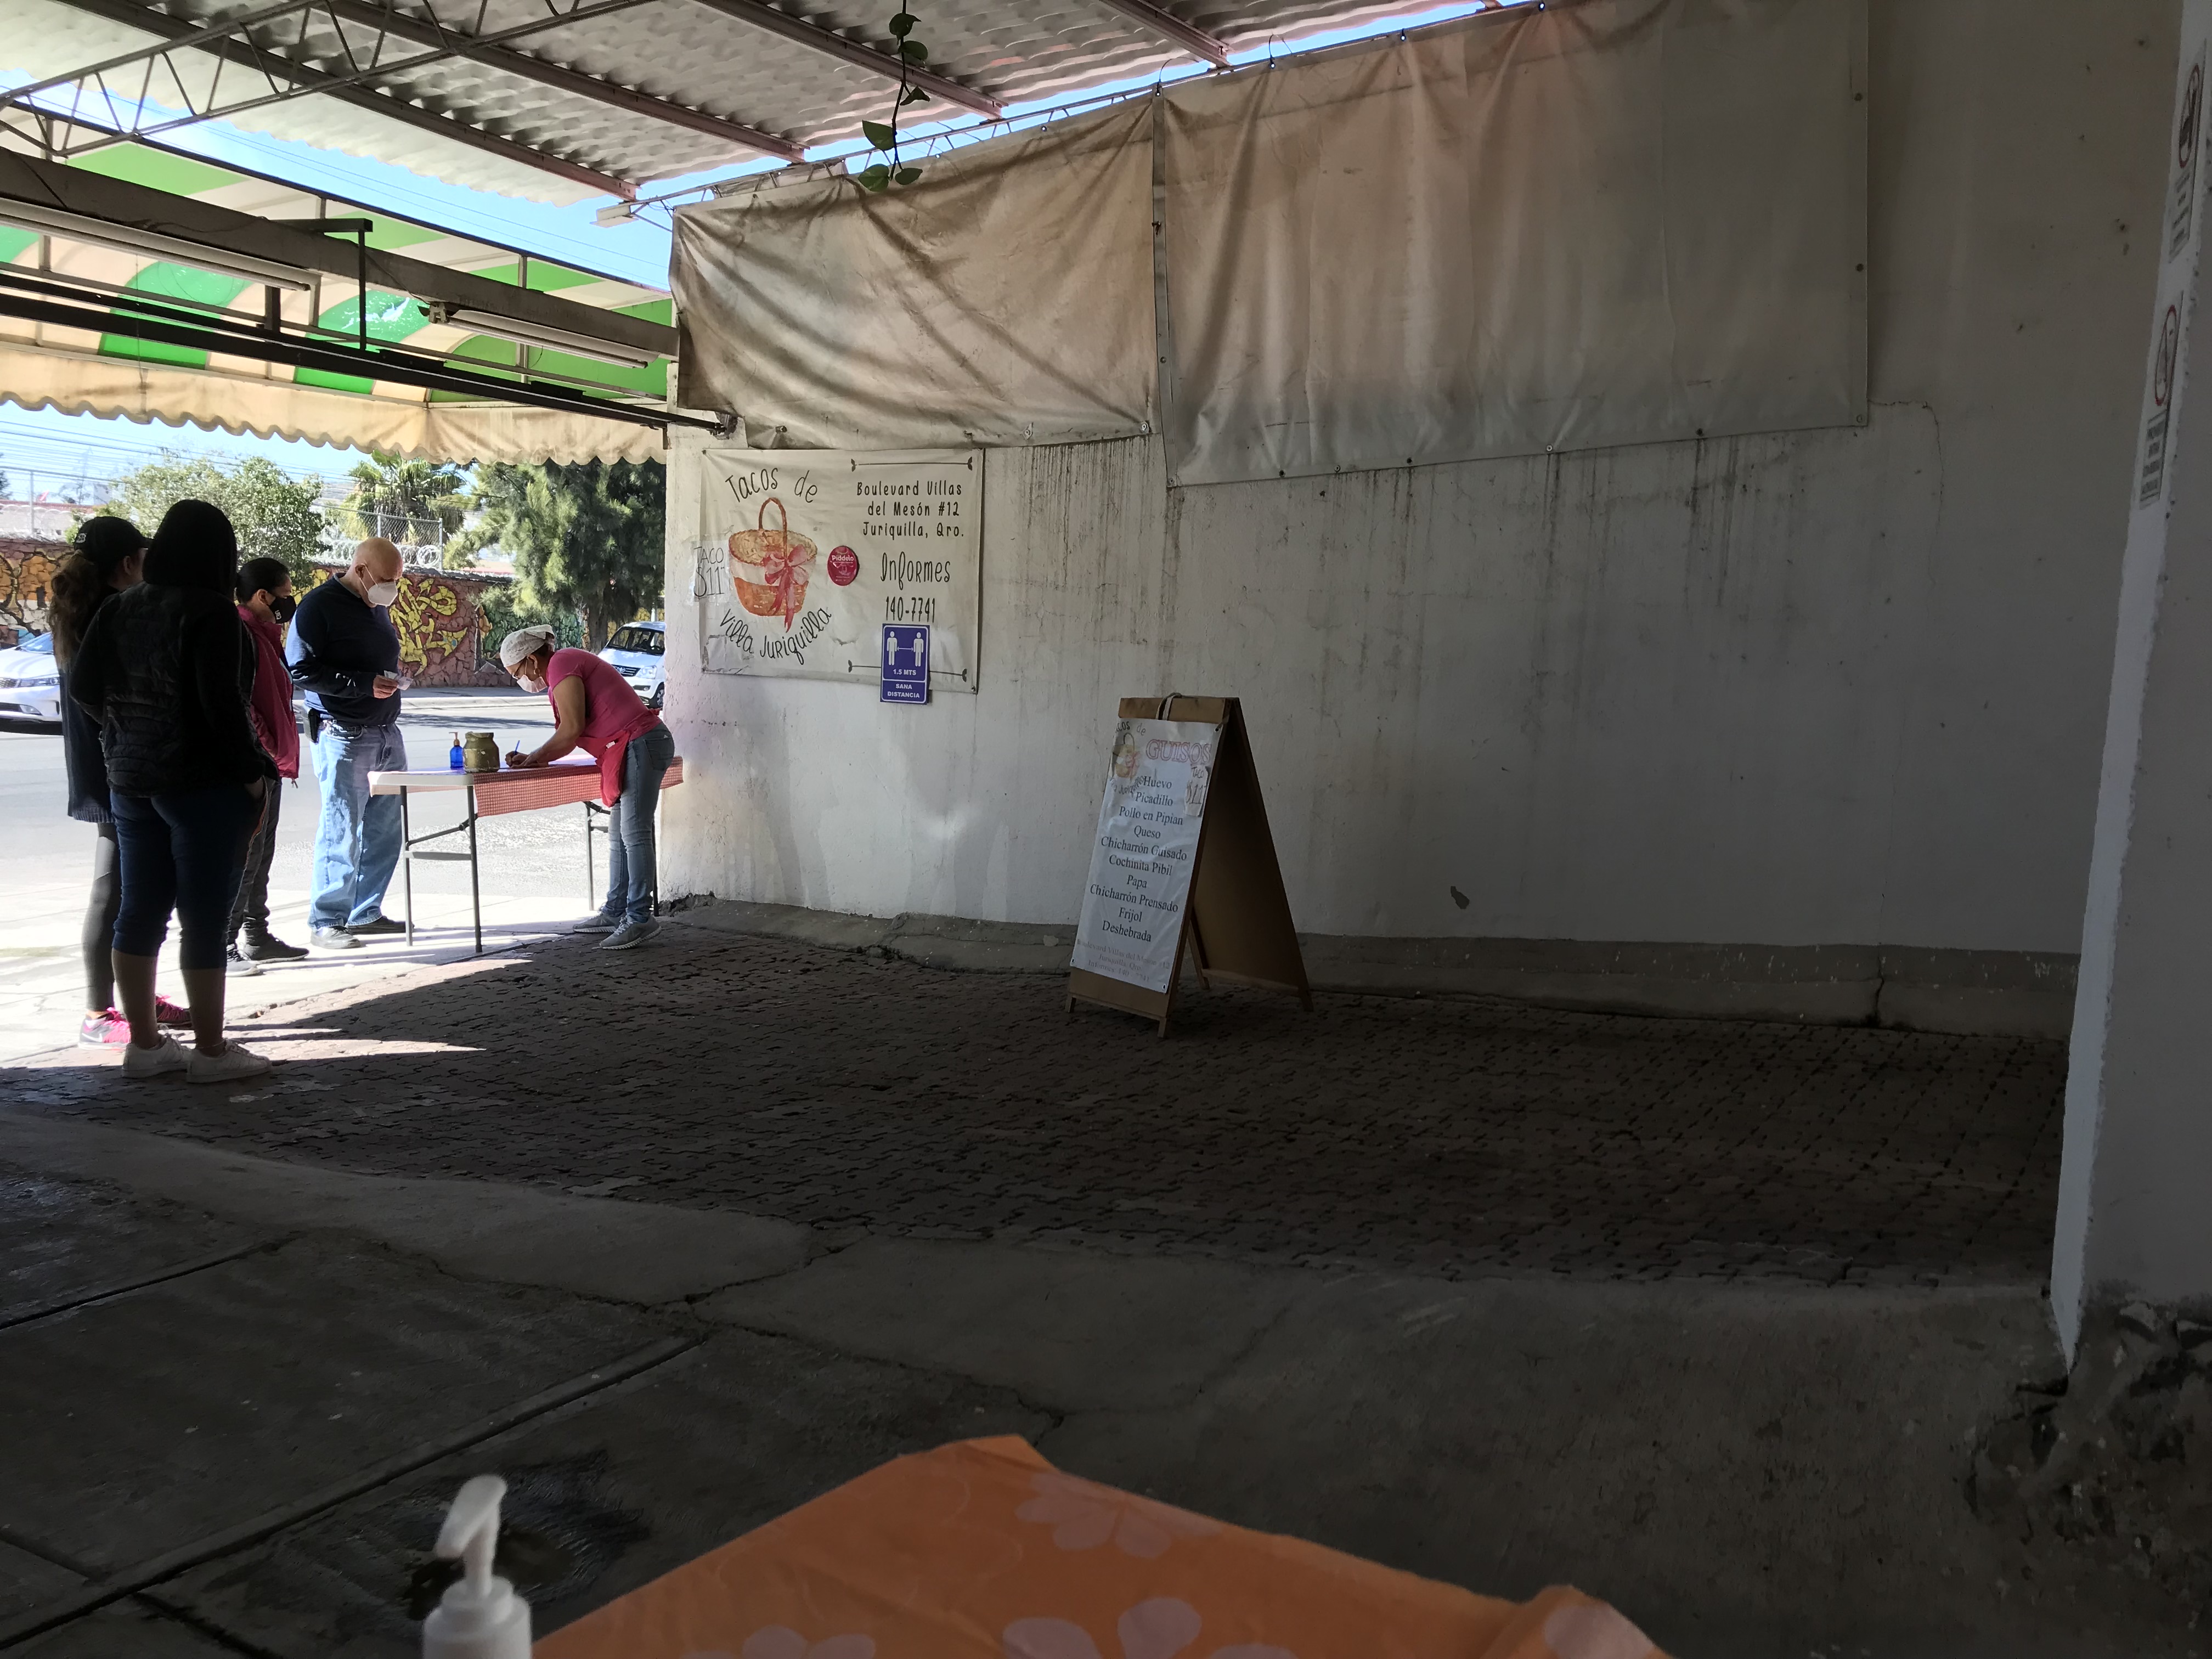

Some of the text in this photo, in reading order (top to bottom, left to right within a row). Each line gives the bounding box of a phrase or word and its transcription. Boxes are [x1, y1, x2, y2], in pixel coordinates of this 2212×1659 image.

[725, 467, 818, 504] Tacos de
[856, 481, 962, 496] Boulevard Villas
[867, 501, 960, 517] del Mesón #12
[863, 521, 964, 538] Juriquilla, Qro.
[693, 546, 724, 564] TACO
[885, 596, 936, 624] 140-7741
[719, 608, 754, 654] Villa
[887, 690, 921, 699] DISTANCIA
[1136, 722, 1146, 736] de
[1146, 738, 1212, 765] GUISOS
[1143, 775, 1172, 789] Huevo
[1135, 791, 1173, 807] Picadillo
[1119, 806, 1183, 826] Pollo en Pipian
[1133, 825, 1161, 839] Queso
[1101, 836, 1188, 861] Chicharrón Guisado
[1109, 854, 1173, 876] Cochinita Pibil
[1126, 874, 1148, 890] Papa
[1090, 883, 1179, 913] Chicharrón Prensado
[1118, 906, 1143, 923] Frijol
[1102, 920, 1152, 943] Deshebrada
